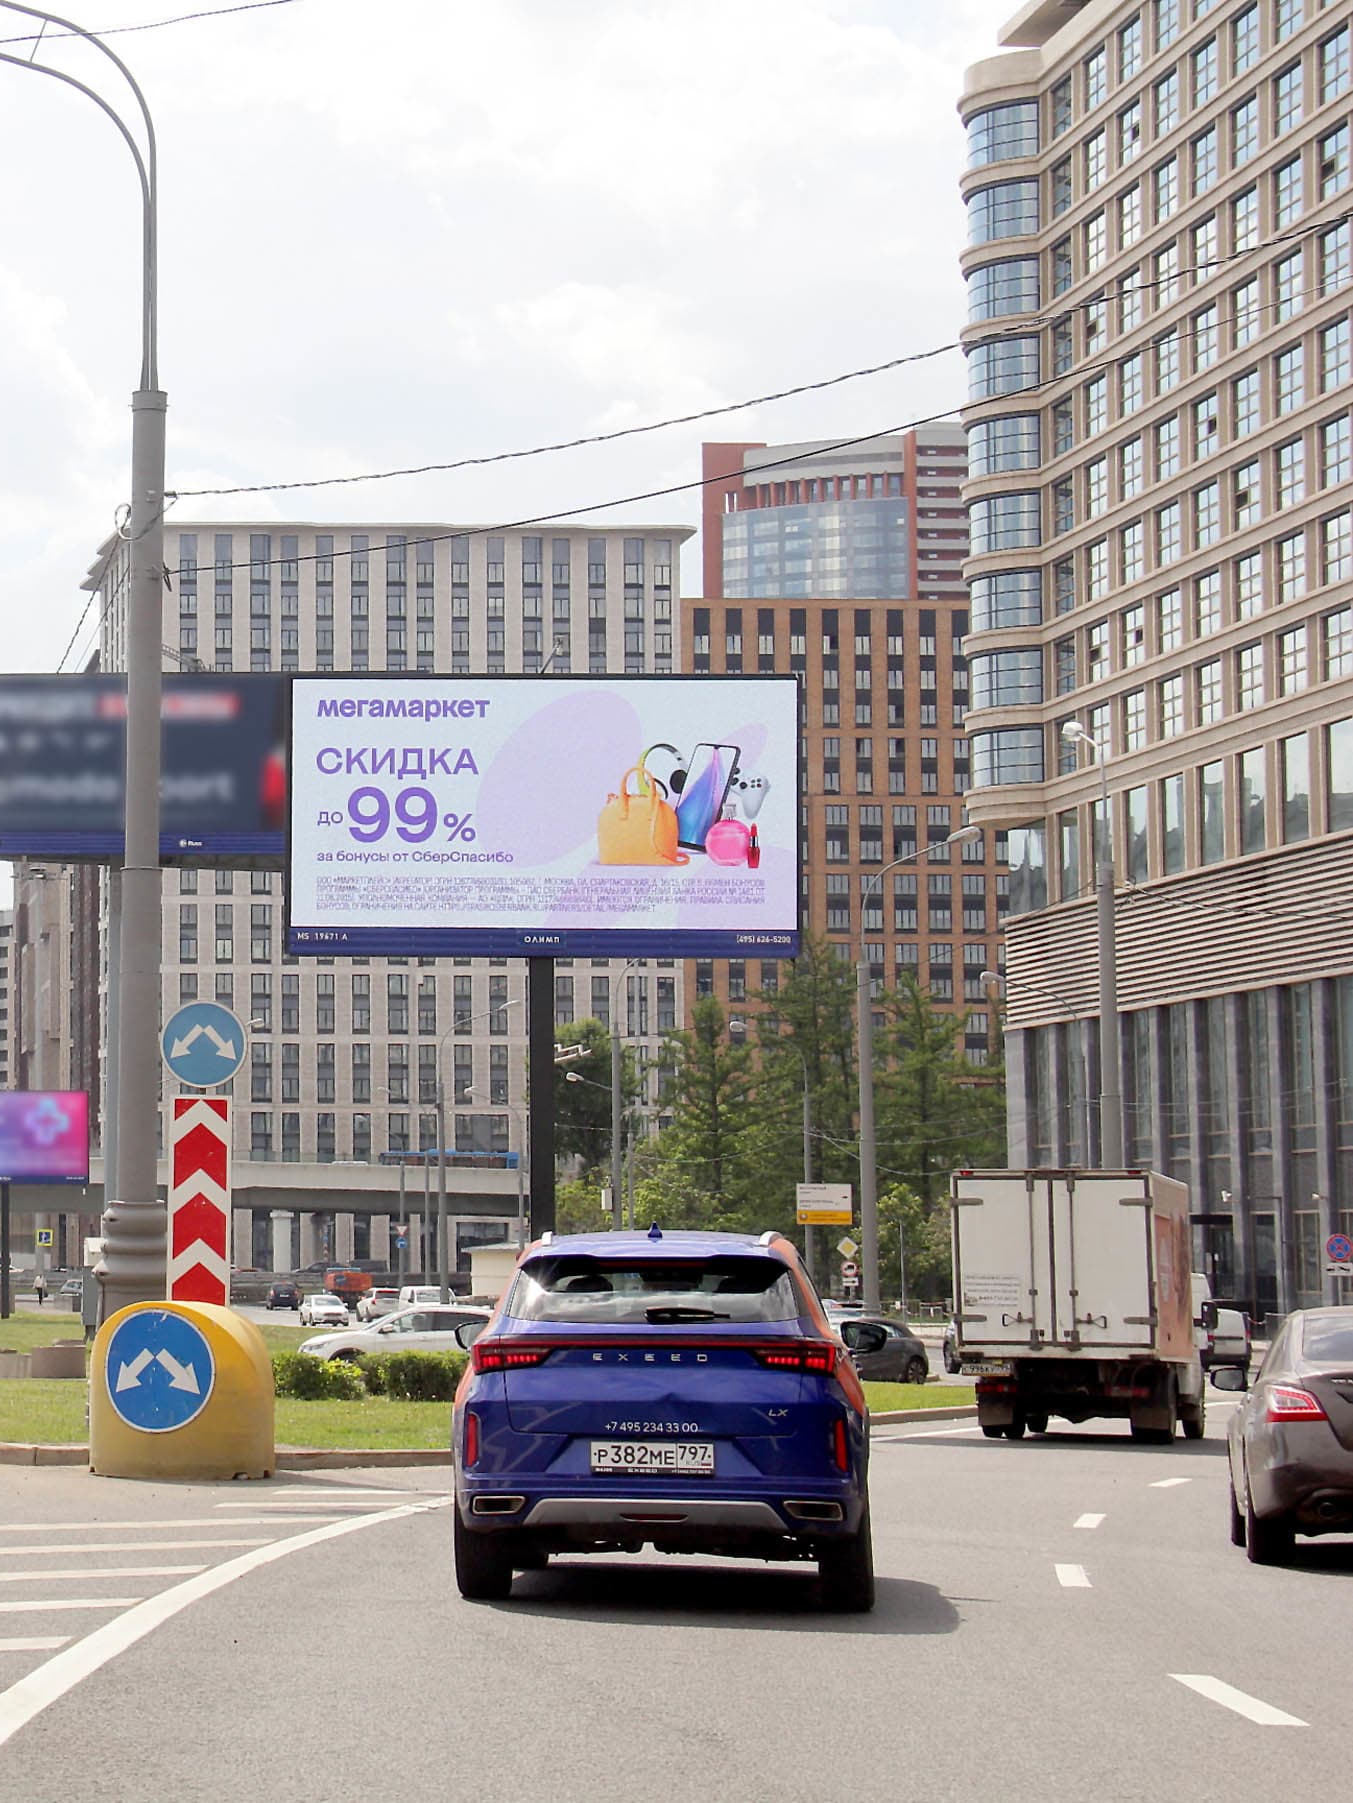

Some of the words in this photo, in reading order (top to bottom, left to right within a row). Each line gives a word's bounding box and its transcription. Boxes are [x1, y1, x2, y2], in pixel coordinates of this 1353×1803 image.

[316, 698, 491, 722] мегамаркет
[316, 747, 479, 780] СКИДКА
[316, 811, 344, 826] до
[316, 853, 334, 863] за
[336, 850, 390, 866] бонусы
[393, 853, 410, 863] от
[412, 851, 515, 866] СберСпасибо
[592, 1352, 708, 1363] EXEED
[768, 1408, 789, 1417] LX
[604, 1422, 618, 1431] +7
[619, 1422, 641, 1432] 495
[643, 1422, 663, 1433] 234
[665, 1423, 679, 1433] 33
[682, 1423, 698, 1433] 00
